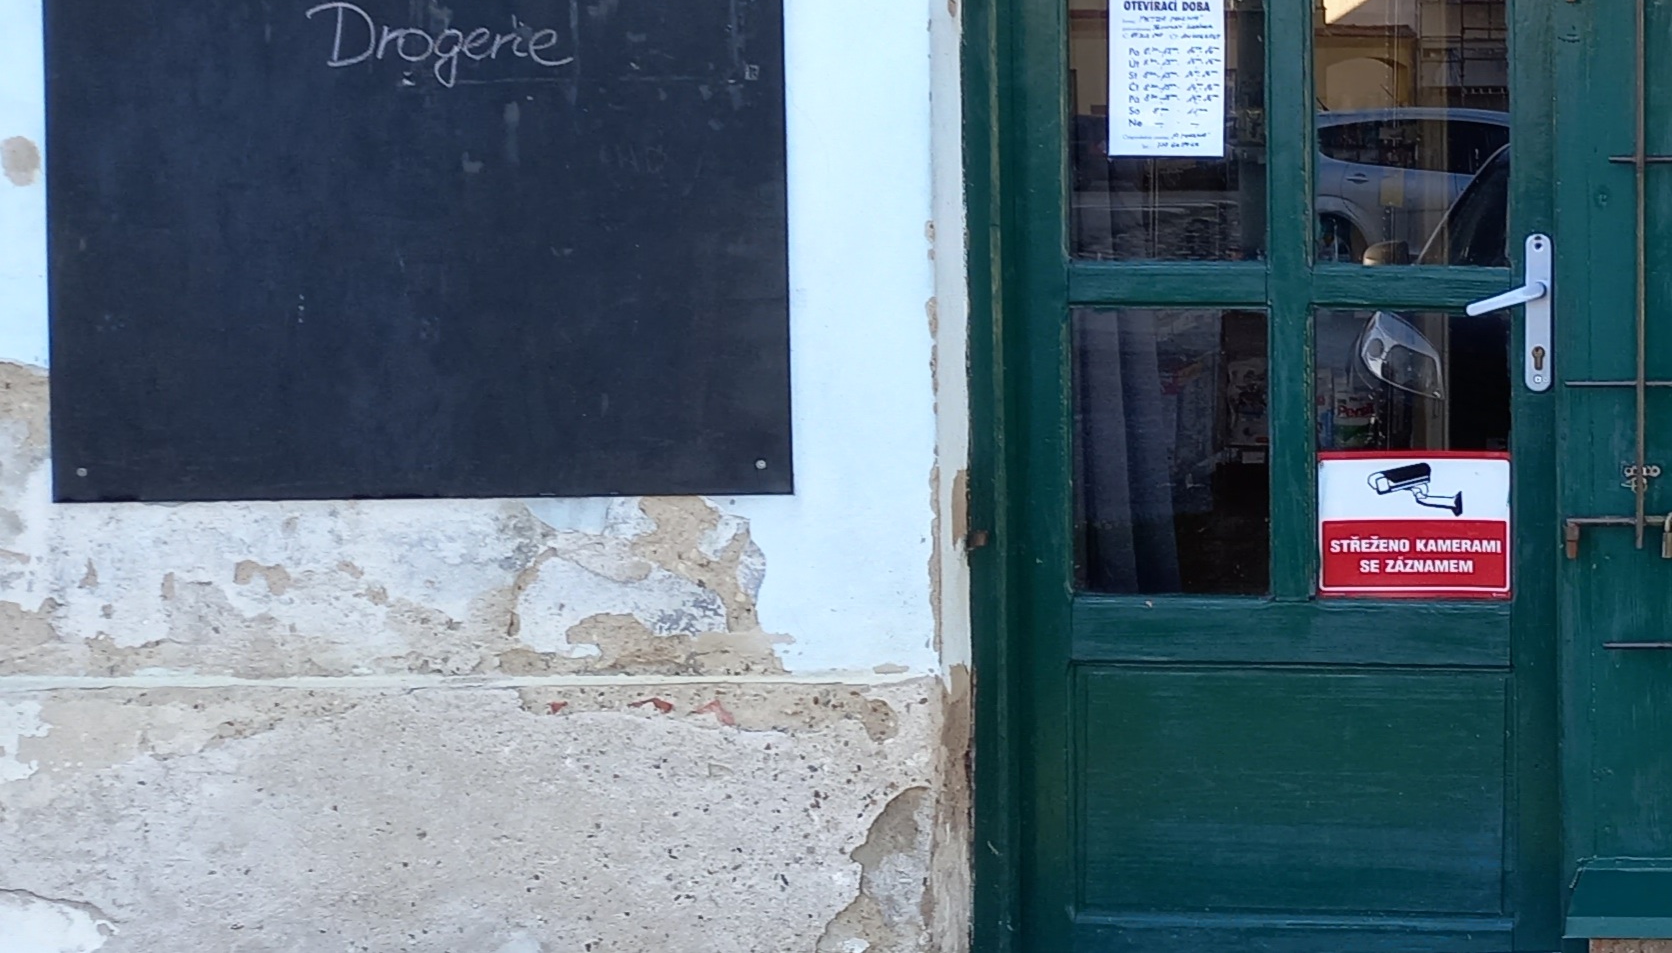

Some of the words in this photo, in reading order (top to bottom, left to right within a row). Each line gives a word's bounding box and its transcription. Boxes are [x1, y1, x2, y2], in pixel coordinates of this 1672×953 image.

[1182, 1, 1211, 12] DOBA
[306, 1, 574, 87] Drogerie
[1330, 535, 1410, 553] STŘEŽENO
[1415, 539, 1501, 554] KAMERAMI
[1359, 559, 1380, 573] SE
[1385, 556, 1473, 573] ZÁZNAMEM
